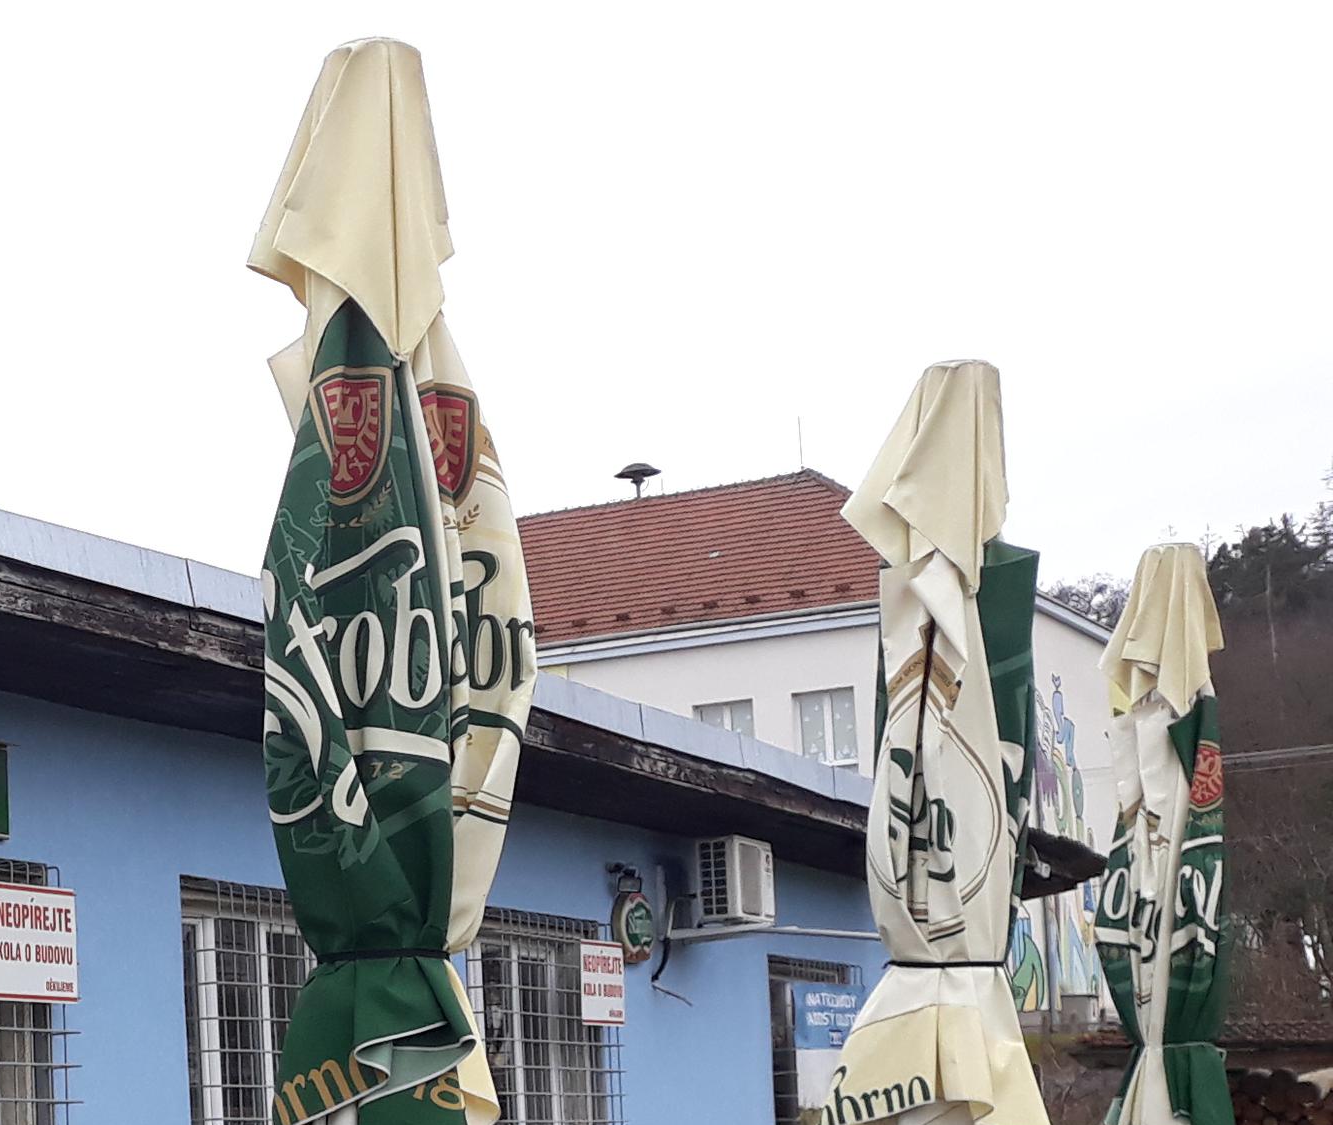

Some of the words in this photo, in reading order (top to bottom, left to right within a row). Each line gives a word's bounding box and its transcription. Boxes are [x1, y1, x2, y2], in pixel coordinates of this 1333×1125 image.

[370, 761, 404, 780] 72
[25, 944, 31, 962] O
[35, 943, 73, 966] BUDOVU
